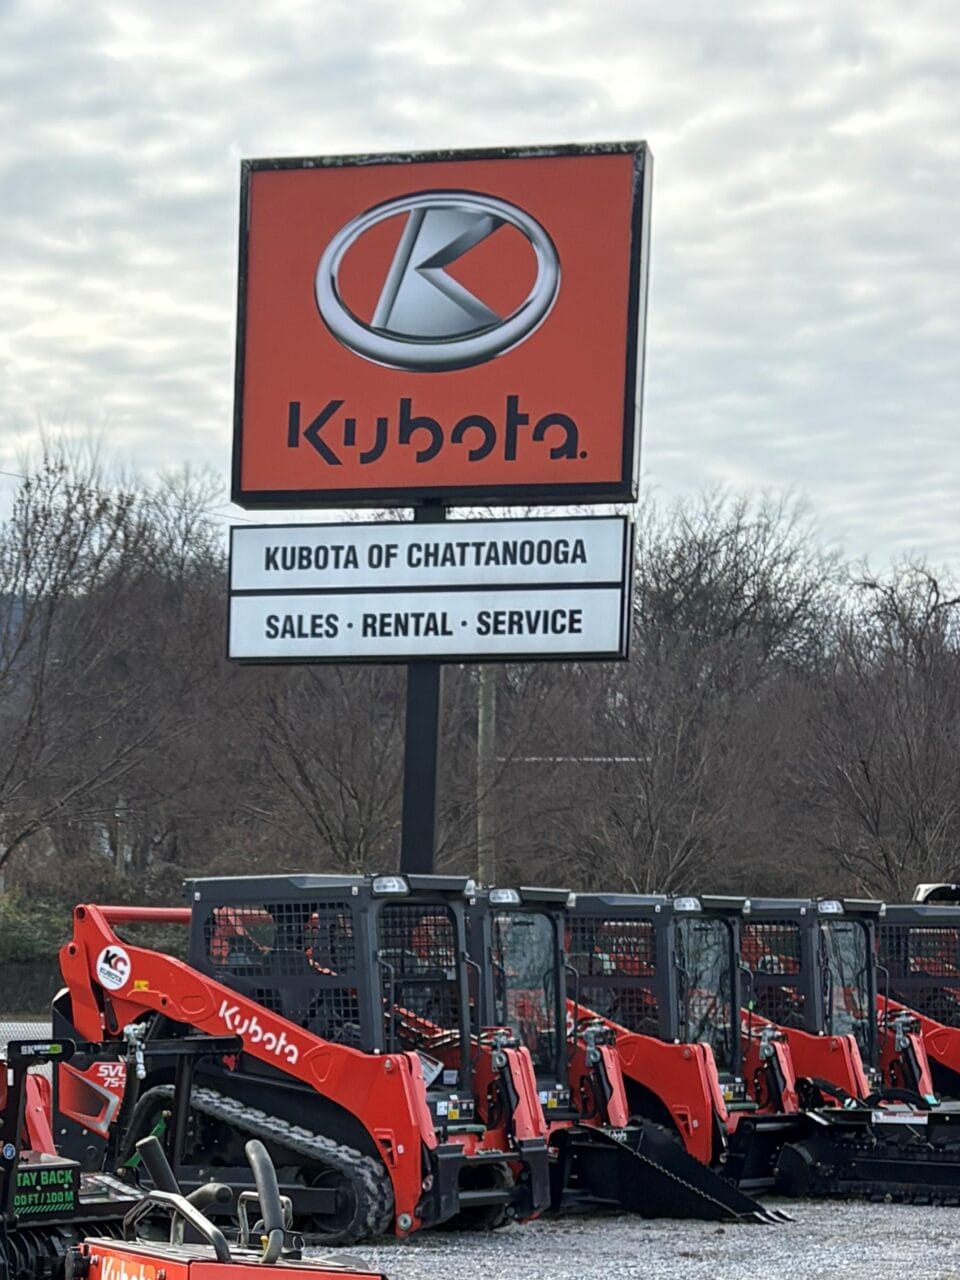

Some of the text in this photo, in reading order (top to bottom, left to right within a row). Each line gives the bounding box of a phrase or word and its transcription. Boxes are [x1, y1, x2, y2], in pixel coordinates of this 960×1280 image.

[264, 538, 588, 571] KUBOTA OF CHATTANOOGA
[265, 608, 583, 639] SALES RENTAL SERVICE
[218, 1000, 299, 1065] Kubota
[96, 1064, 127, 1078] SVL
[40, 1168, 74, 1185] BACK
